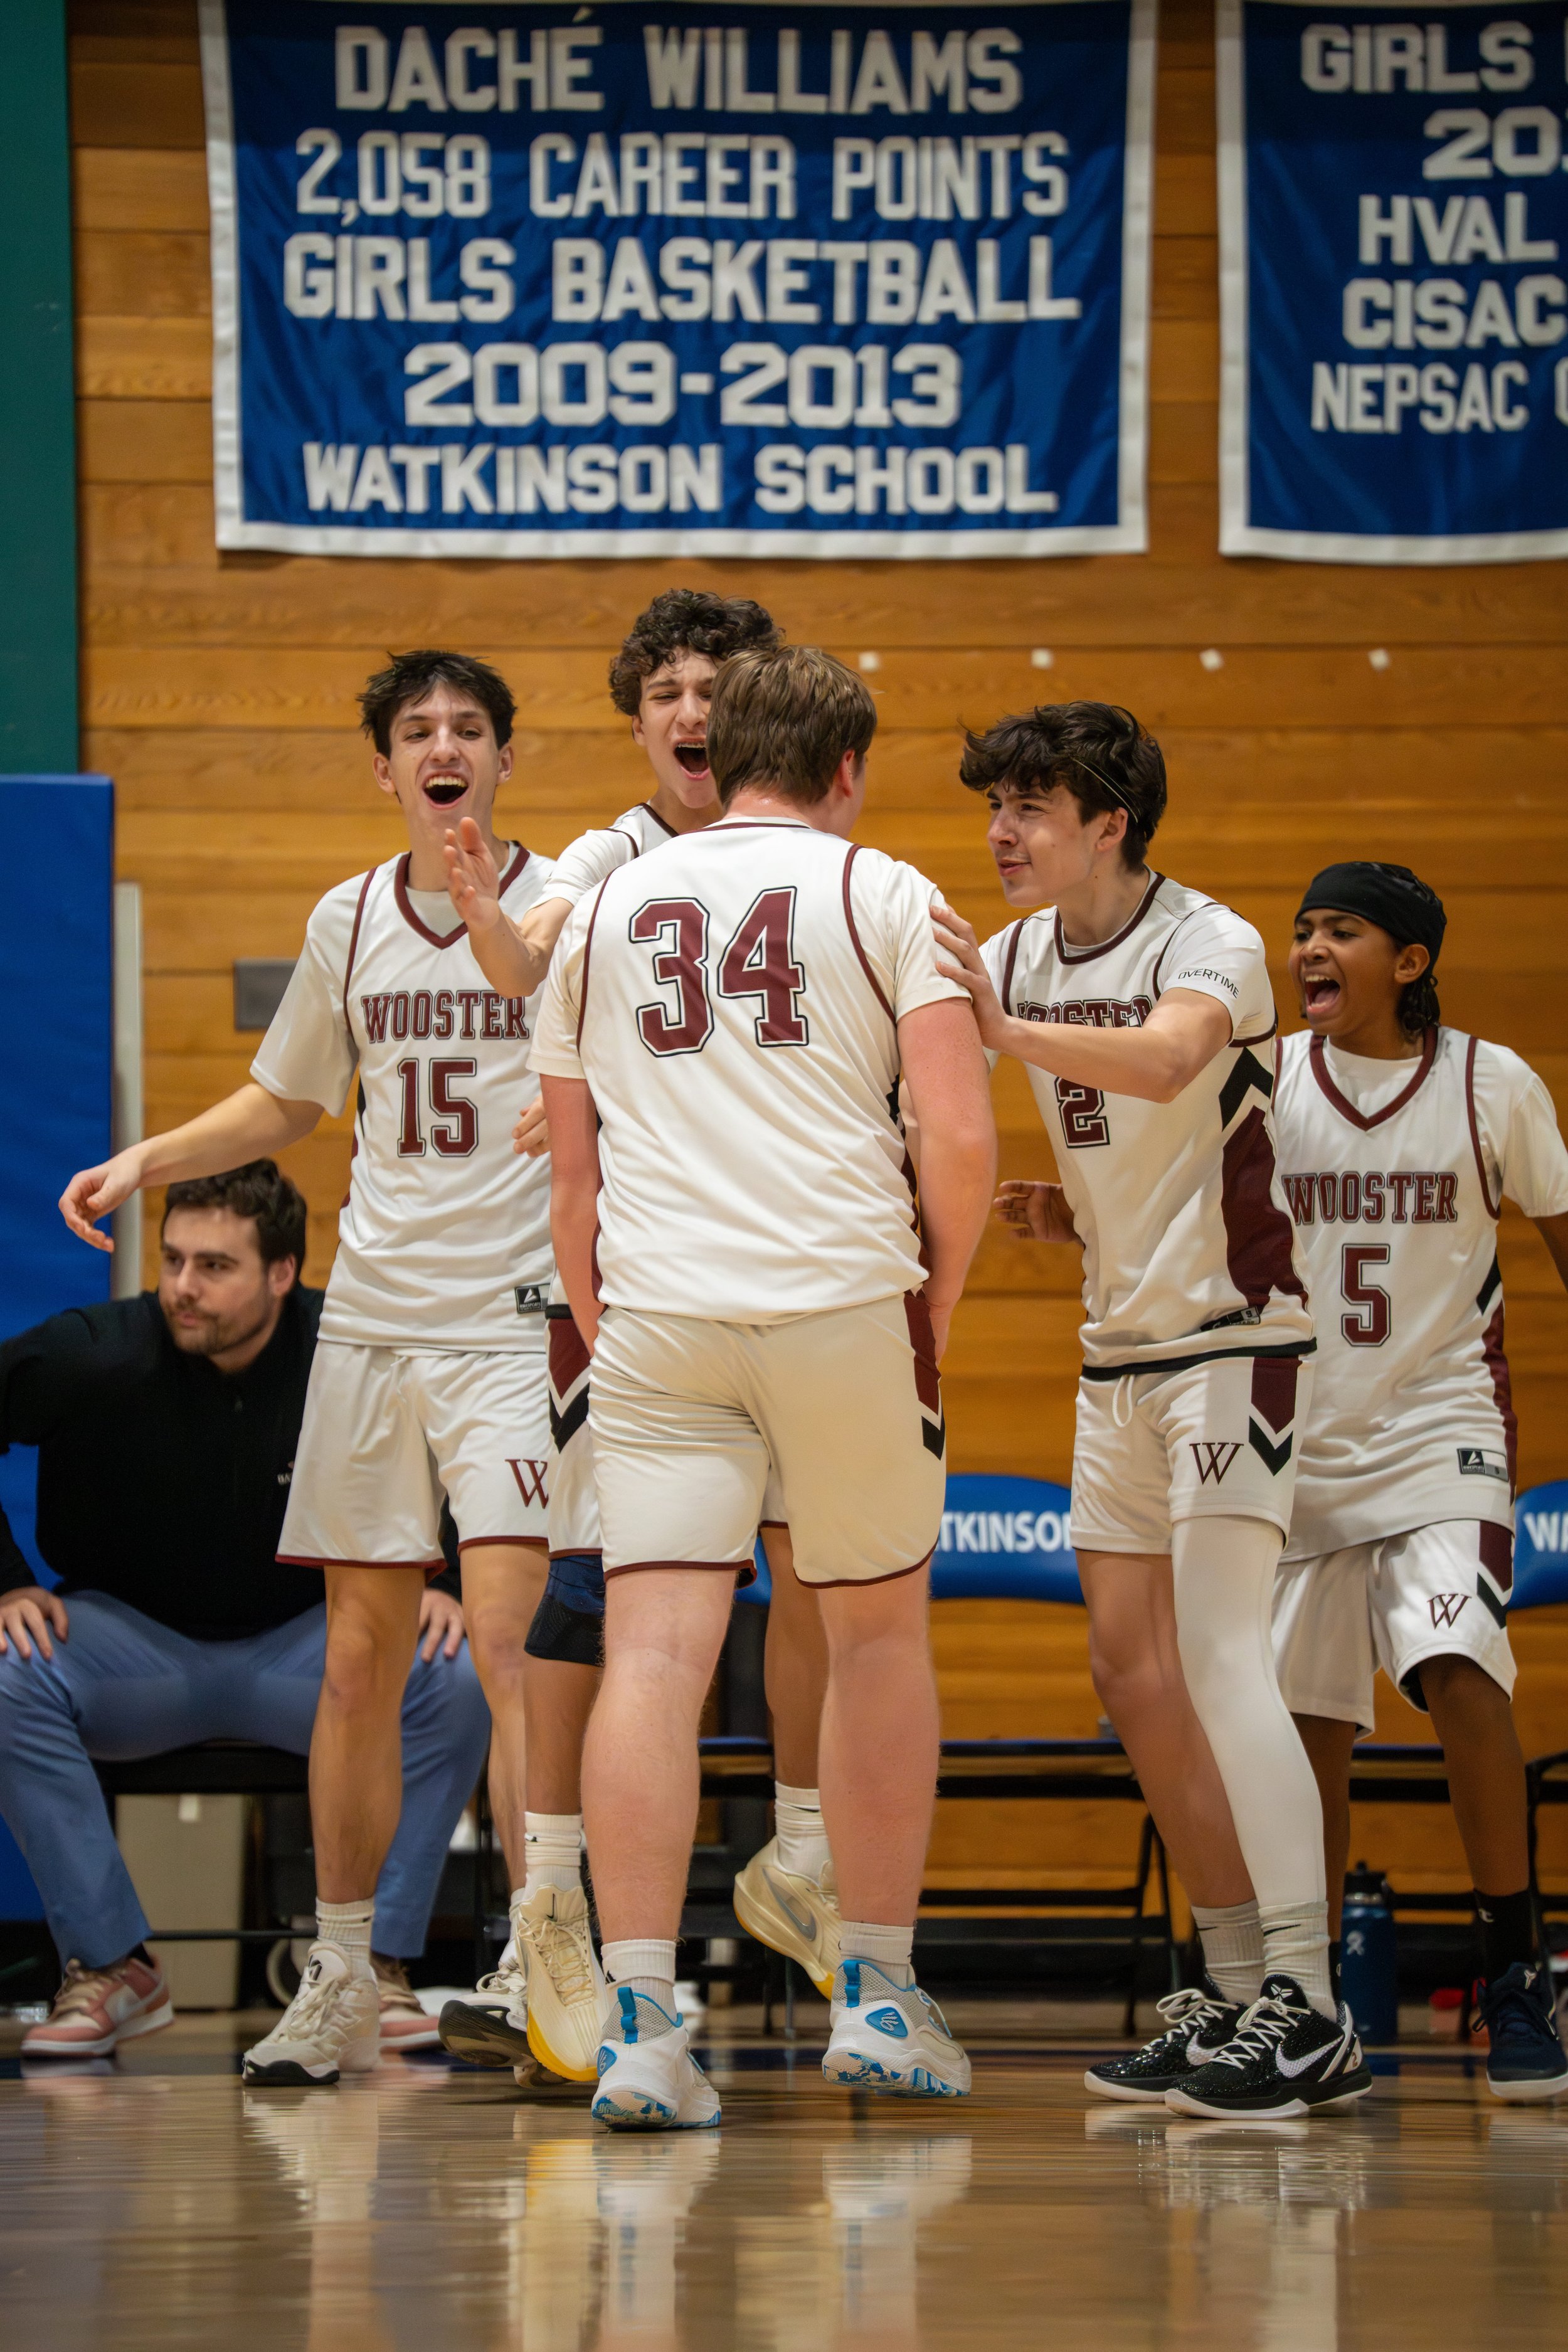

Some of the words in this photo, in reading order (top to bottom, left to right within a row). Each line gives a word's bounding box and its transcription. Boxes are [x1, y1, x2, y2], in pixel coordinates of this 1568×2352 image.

[335, 8, 605, 112] DACHÉ
[644, 25, 1024, 114] WILLIAMS
[1301, 21, 1534, 93] GIRLS
[295, 127, 492, 226] 2,058
[529, 131, 797, 220] CAREER
[831, 130, 1069, 221] POINTS
[1422, 106, 1568, 180] 20
[1358, 191, 1558, 265] HVAL
[283, 231, 517, 324] GIRLS
[551, 235, 1082, 326] BASKETBALL
[1342, 274, 1568, 349] CISAC
[403, 340, 962, 430] 2009-2013
[1310, 361, 1529, 434] NEPSAC
[302, 441, 723, 515] WATKINSON
[753, 443, 1059, 516] SCHOOL
[628, 886, 809, 1057] 34
[1178, 968, 1240, 999] OVERTIME
[361, 989, 530, 1044] WOOSTER
[397, 1057, 479, 1157] 15
[1054, 1076, 1111, 1148] 2
[1281, 1171, 1458, 1224] WOOSTER
[1340, 1243, 1391, 1347] 5
[1189, 1442, 1244, 1485] W
[1427, 1594, 1472, 1629] W
